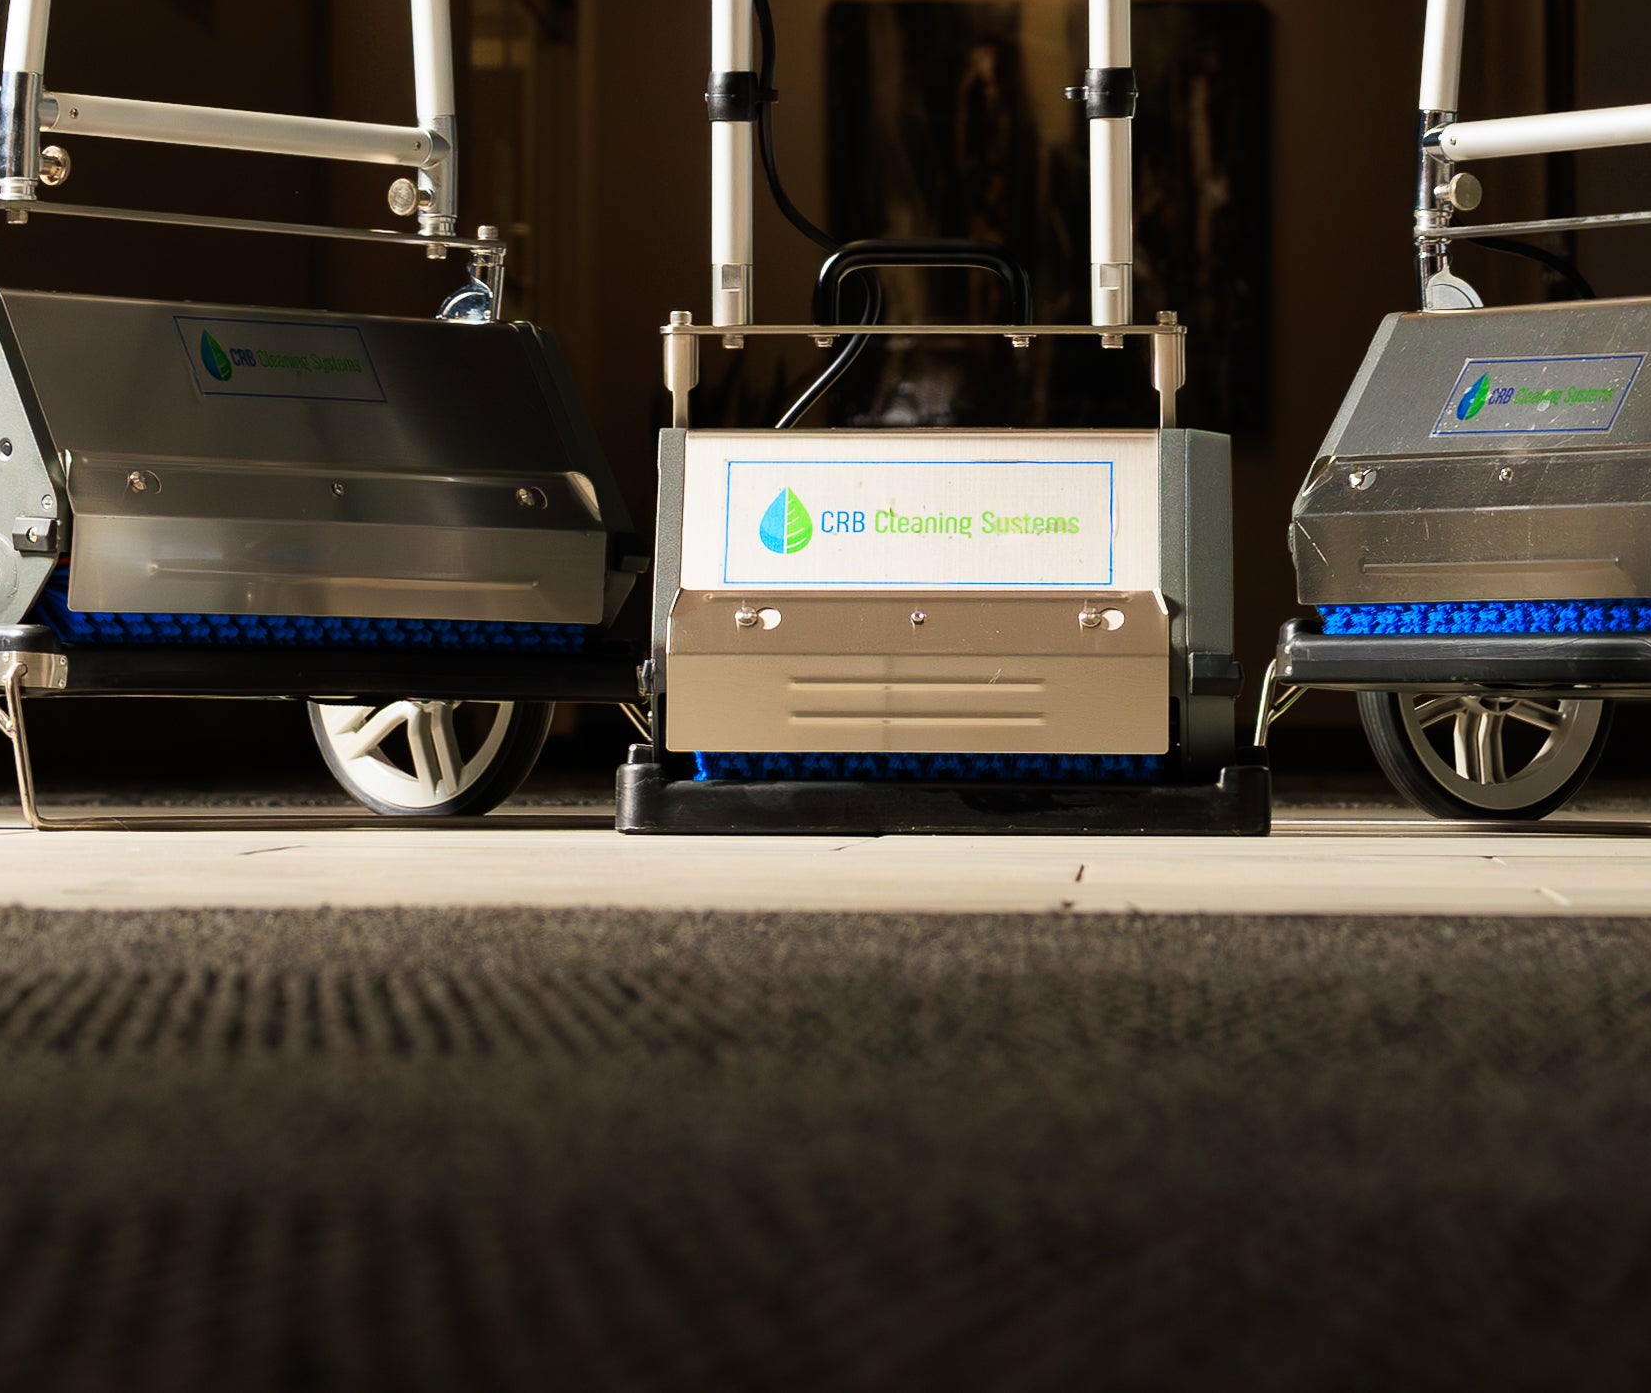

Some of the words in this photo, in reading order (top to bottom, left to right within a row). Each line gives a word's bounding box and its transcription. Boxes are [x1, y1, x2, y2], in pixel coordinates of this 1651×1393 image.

[229, 348, 257, 367] CRB
[257, 349, 312, 372] Cleaning
[312, 353, 362, 374] Systems
[1488, 387, 1515, 405] CRB
[1514, 386, 1564, 407] Cleaning
[1563, 386, 1616, 407] Systems
[821, 510, 865, 534] CRB
[874, 510, 972, 539] Cleaning
